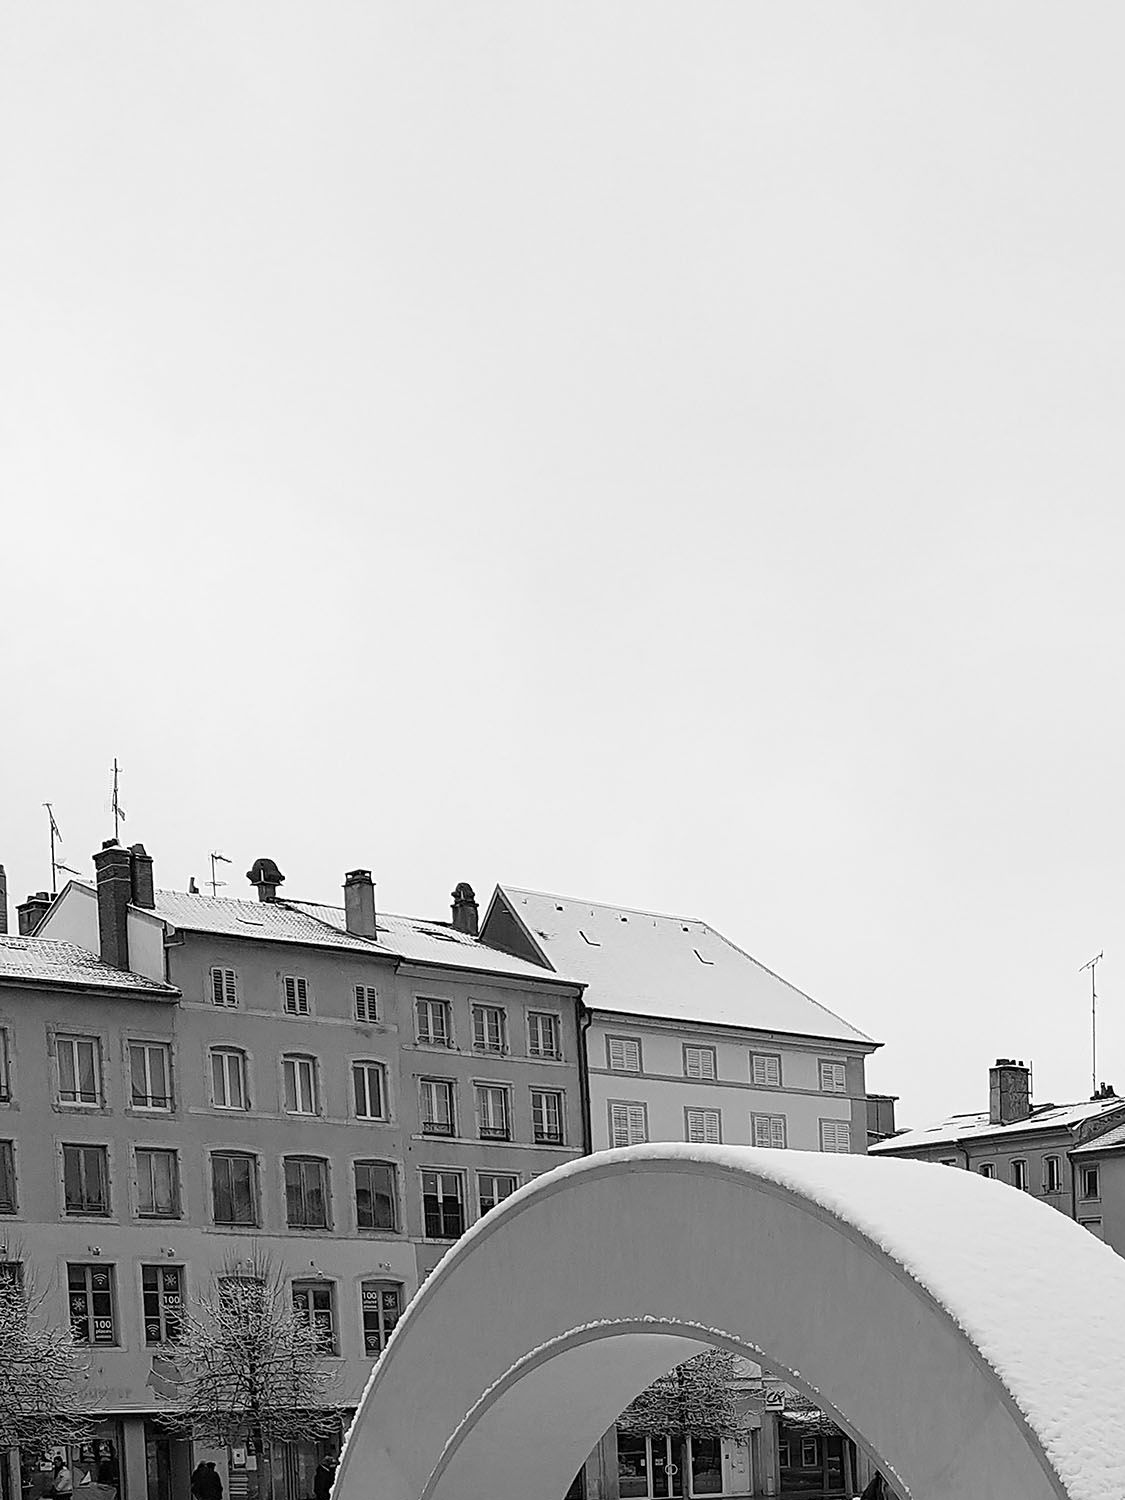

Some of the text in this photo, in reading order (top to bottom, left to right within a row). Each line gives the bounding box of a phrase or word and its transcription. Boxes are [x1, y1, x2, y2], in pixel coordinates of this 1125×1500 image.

[163, 1295, 180, 1304] 100
[362, 1291, 377, 1300] 100
[94, 1320, 112, 1329] 100
